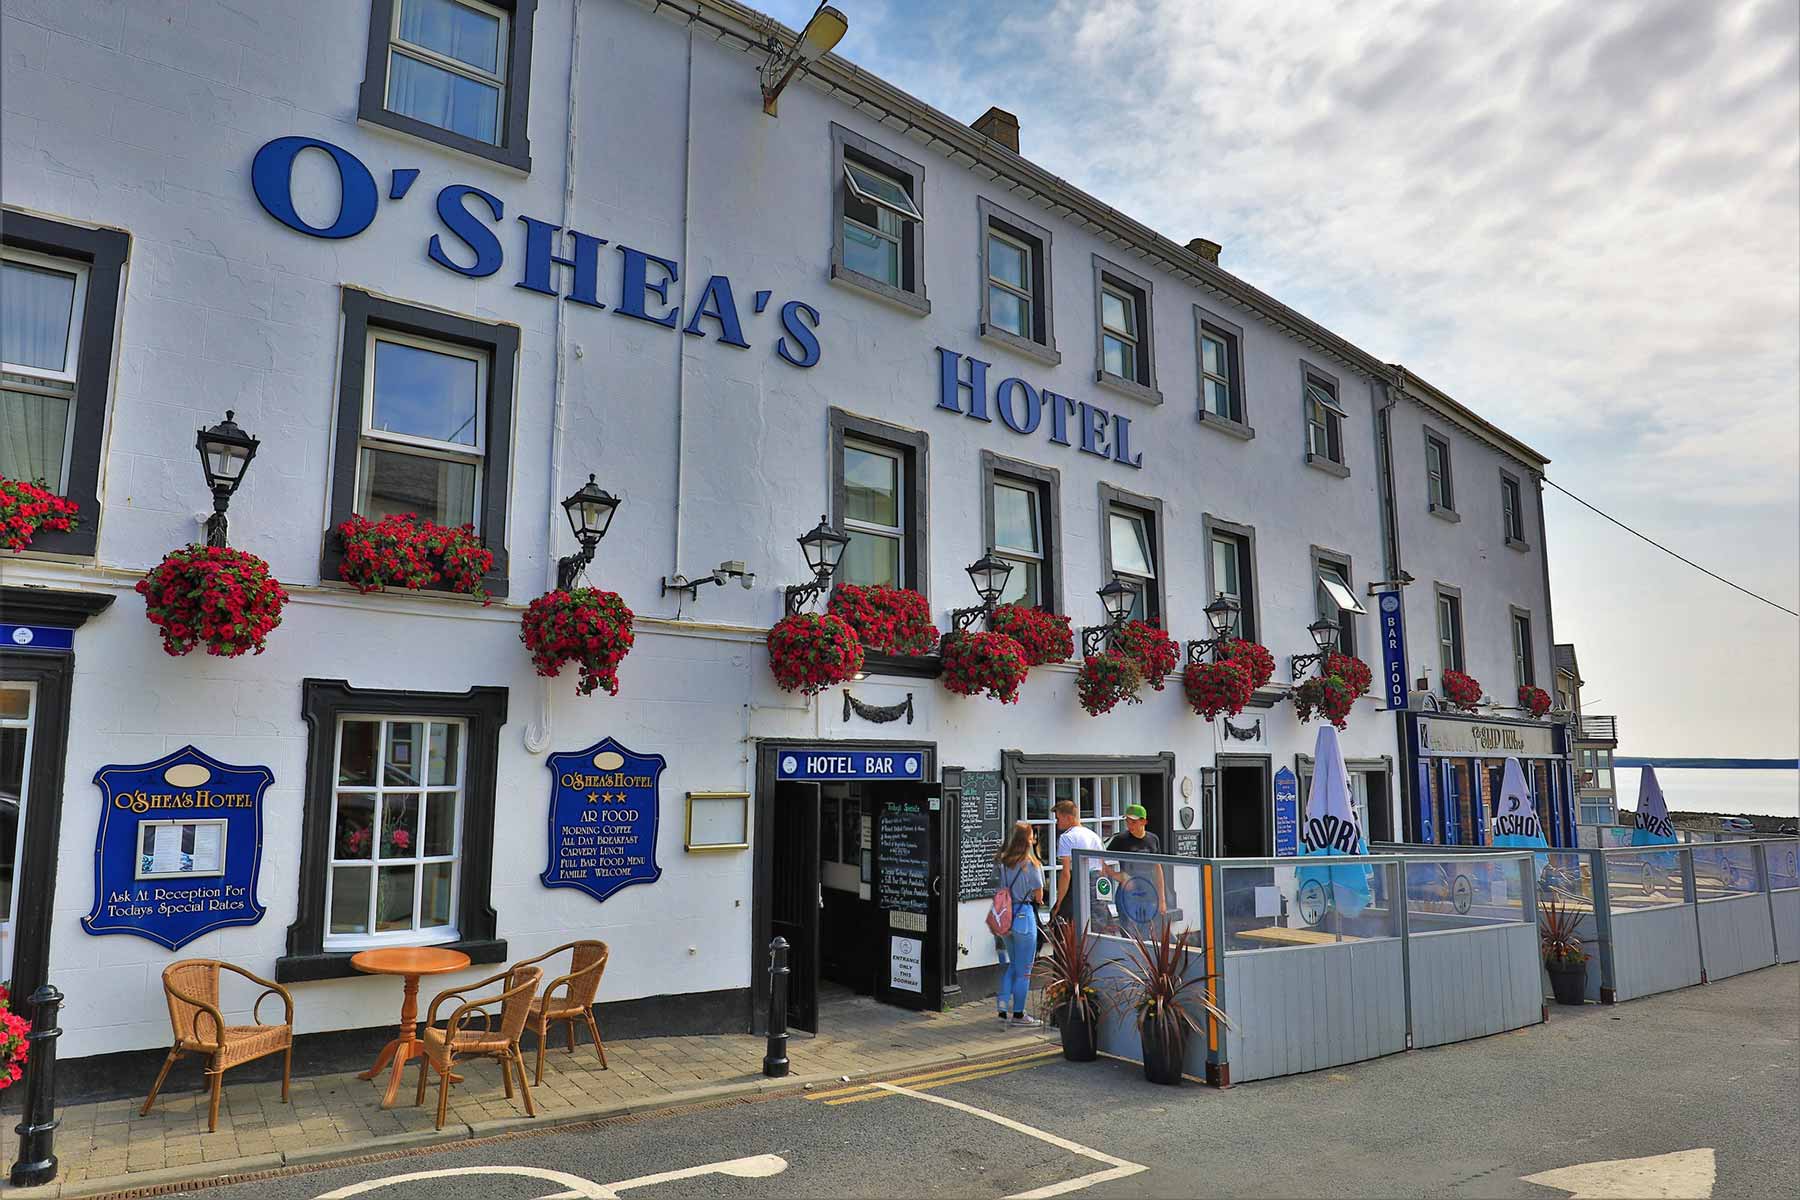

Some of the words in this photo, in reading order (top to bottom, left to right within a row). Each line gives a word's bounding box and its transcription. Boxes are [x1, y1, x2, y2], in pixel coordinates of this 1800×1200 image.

[251, 135, 821, 368] O'SHEA'S
[935, 345, 1143, 469] HOTEL
[1387, 617, 1397, 649] BAR
[1391, 662, 1402, 706] FOOD
[807, 757, 856, 774] HOTEL
[866, 757, 893, 774] BAR
[614, 772, 652, 788] HOTEL
[114, 789, 194, 813] O'SHEA'S
[195, 790, 253, 808] HOTEL
[602, 809, 639, 822] FOOD
[562, 826, 600, 836] MORNING
[603, 825, 632, 834] COFFEE
[561, 836, 575, 846] ALL
[578, 836, 595, 846] DAY
[597, 835, 639, 845] BREAKFAST
[560, 847, 598, 857] CARVERY
[600, 846, 624, 856] LUNCH
[560, 858, 577, 869] FULL
[580, 857, 597, 867] BAR
[599, 857, 625, 867] FOOD
[627, 856, 646, 865] MENU
[595, 868, 632, 878] WELCOME
[108, 890, 130, 903] Ask
[135, 889, 150, 902] At
[154, 887, 221, 902] Reception
[225, 885, 246, 897] For
[107, 904, 153, 919] Todays
[157, 901, 204, 917] Special
[209, 899, 245, 911] Rates
[893, 955, 920, 964] ENTRANCE
[893, 977, 918, 986] DOORWAY
